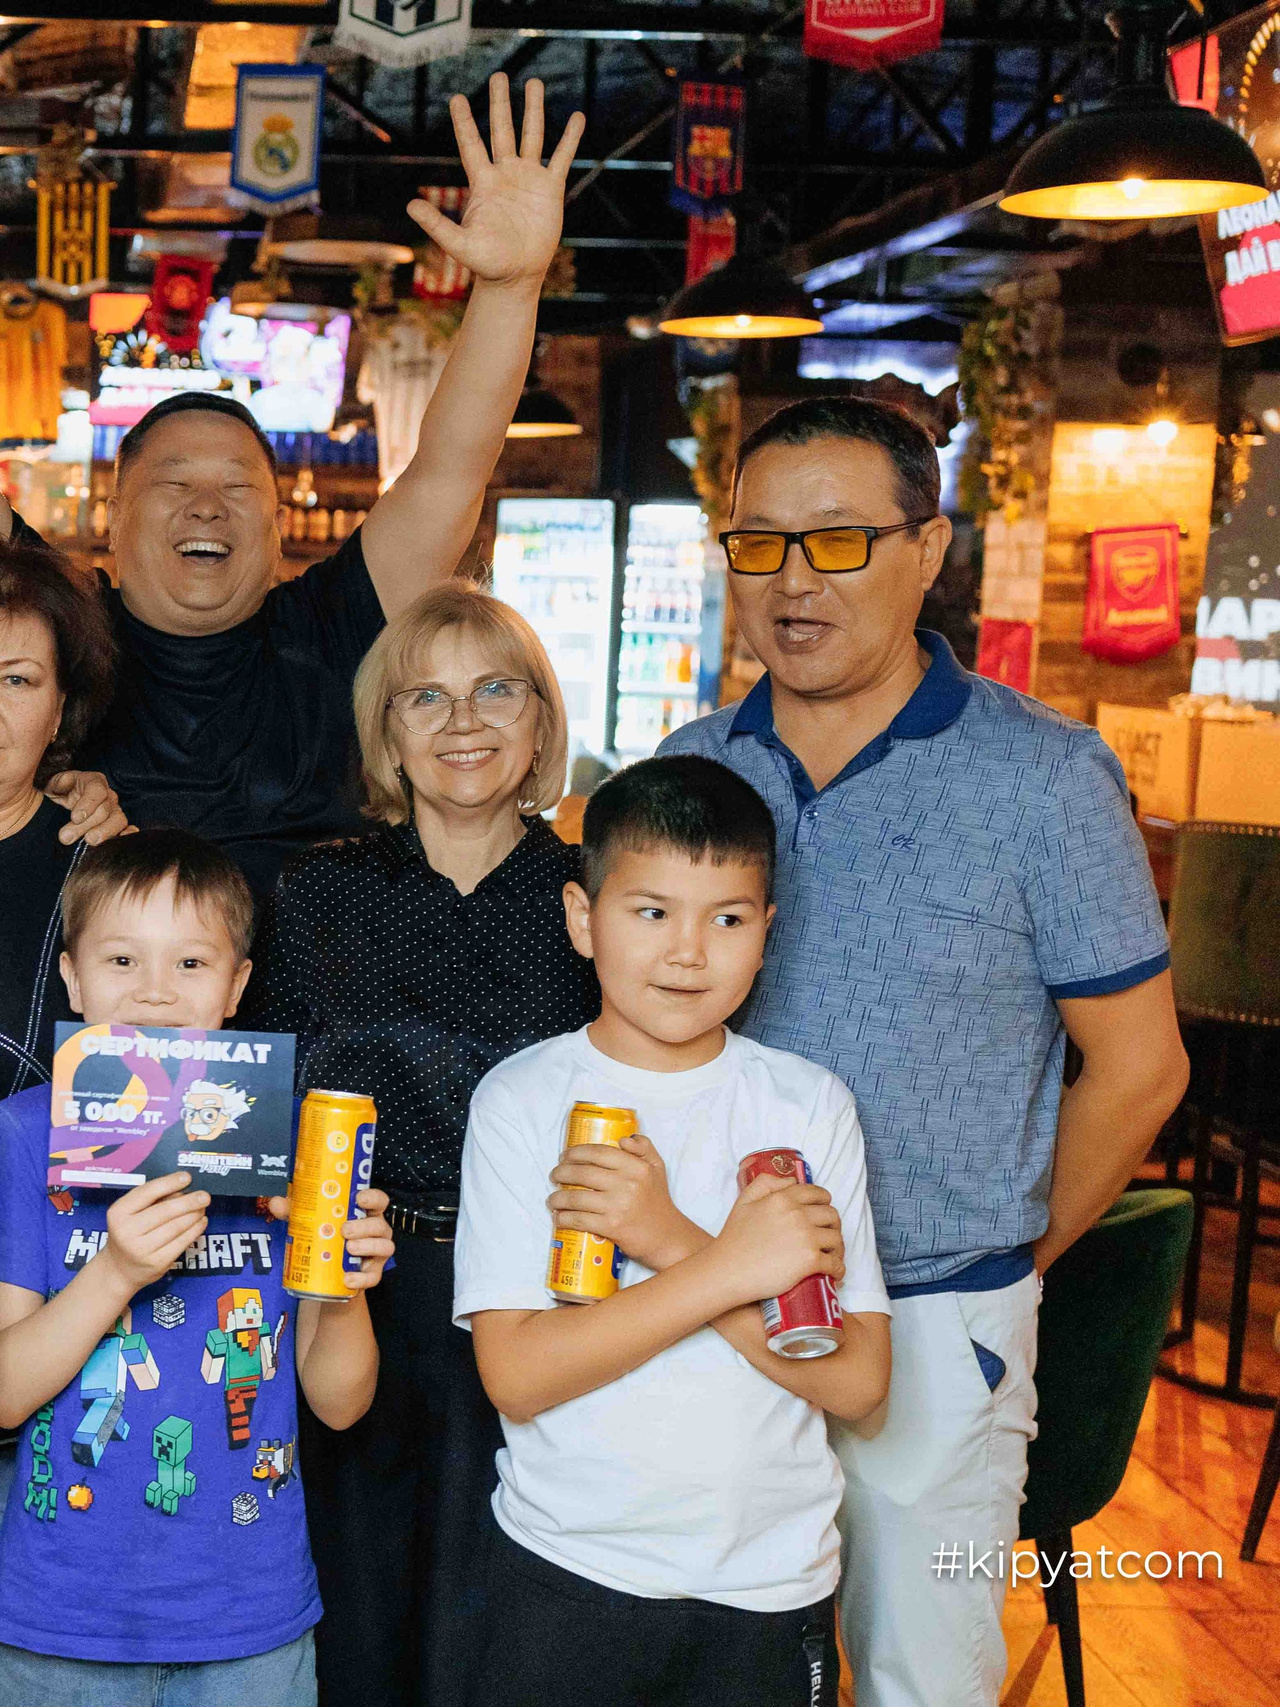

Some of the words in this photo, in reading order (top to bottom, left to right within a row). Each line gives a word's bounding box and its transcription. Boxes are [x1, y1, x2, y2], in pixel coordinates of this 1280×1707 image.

[80, 1034, 272, 1064] СЕРТИФИКАТ
[64, 1100, 81, 1120] 5
[84, 1101, 137, 1123] 000
[810, 1660, 822, 1707] HELL
